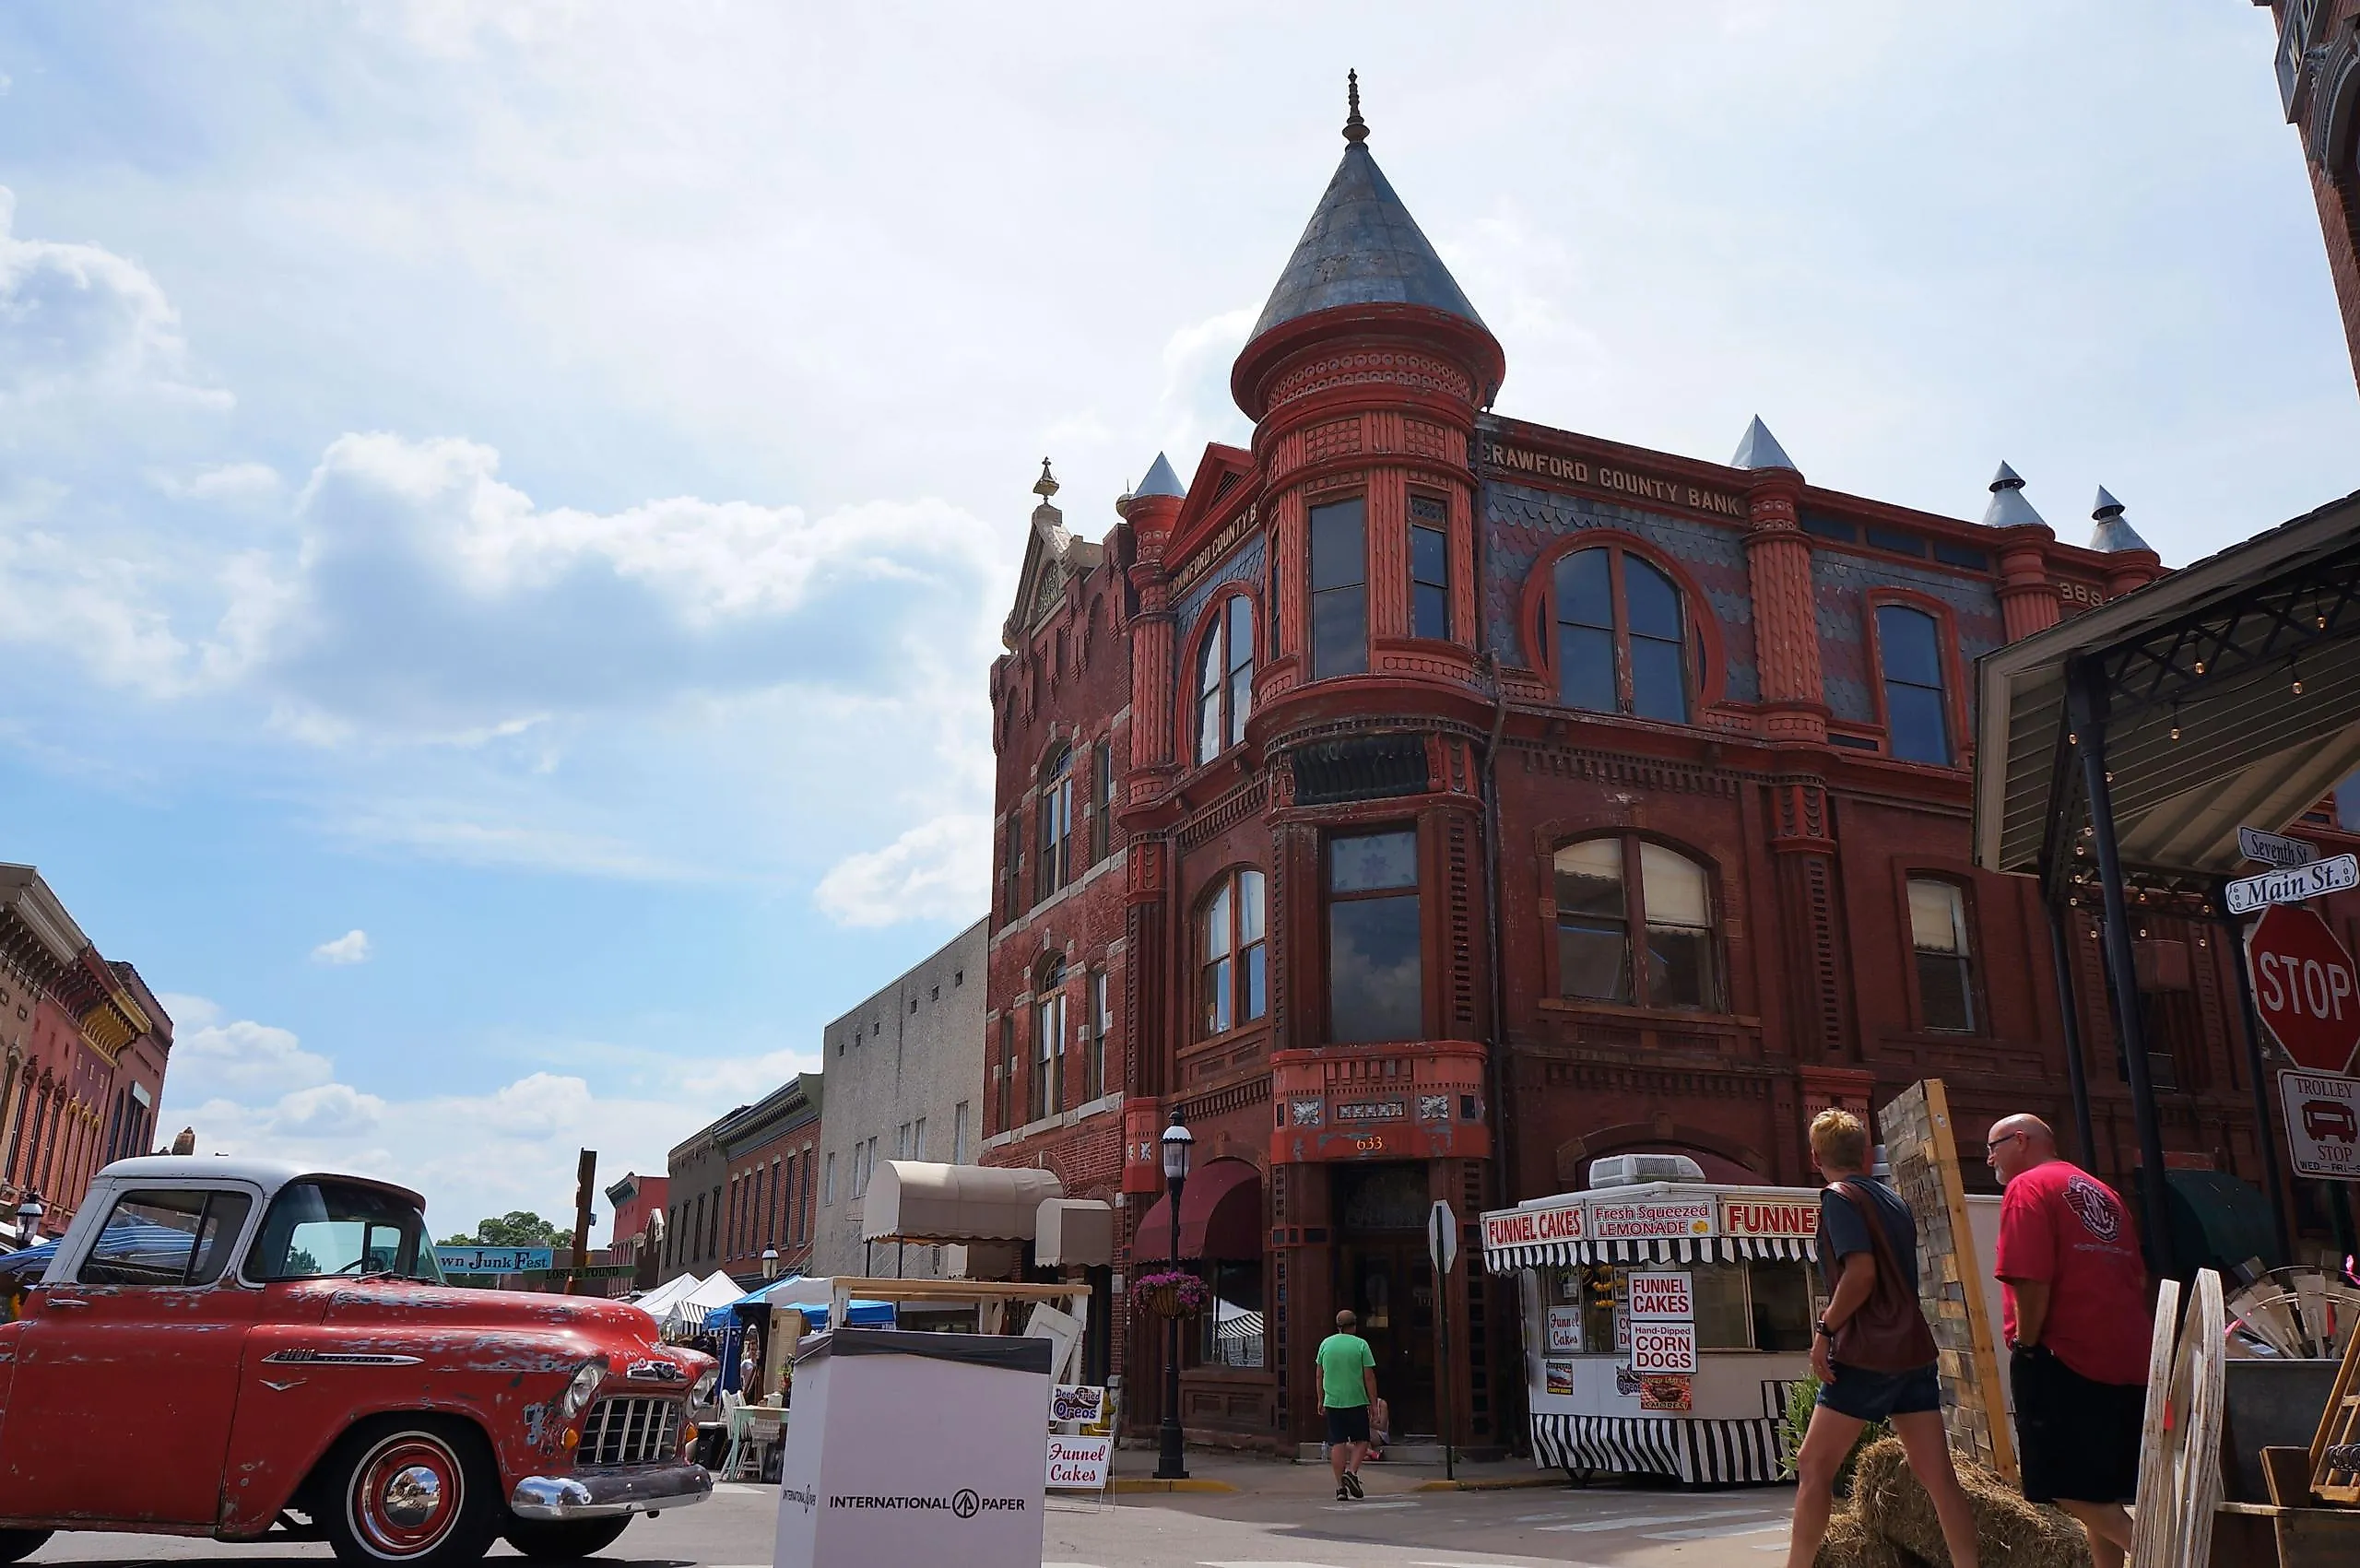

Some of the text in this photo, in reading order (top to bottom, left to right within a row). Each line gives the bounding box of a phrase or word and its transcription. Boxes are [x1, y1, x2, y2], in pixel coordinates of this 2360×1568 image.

[1482, 442, 1740, 514] CRAWFORD COUNTY BANK
[1212, 510, 1248, 557] COUNTY
[2251, 833, 2295, 866] Seventh
[2247, 866, 2340, 905] Main St.
[2260, 951, 2351, 1020] STOP
[2295, 1079, 2353, 1098] TROLLEY
[1356, 1136, 1383, 1150] 633
[2318, 1145, 2353, 1161] STOP
[1595, 1200, 1711, 1221] Fresh Squeezed
[1729, 1204, 1822, 1233] FUNNE
[1488, 1208, 1581, 1244] FUNNEL CAKES
[1599, 1220, 1689, 1237] LEMONADE
[468, 1251, 512, 1269] Junk
[513, 1252, 549, 1269] Fest
[546, 1268, 572, 1279] LOST
[585, 1267, 619, 1278] FOUND
[1633, 1279, 1687, 1294] FUNNEL
[1633, 1295, 1689, 1313] CAKES
[1550, 1314, 1579, 1328] Funnel
[1553, 1331, 1578, 1346] Cakes
[1635, 1326, 1691, 1337] Hand-Dipped
[1635, 1337, 1691, 1351] CORN
[1636, 1352, 1692, 1368] DOGS
[1055, 1388, 1101, 1402] Deep Fried
[1054, 1401, 1097, 1420] Oreos
[1049, 1444, 1106, 1461] Funnel
[1051, 1464, 1096, 1481] Cakes
[830, 1495, 1025, 1511] INTERNATIONAL PAPER
